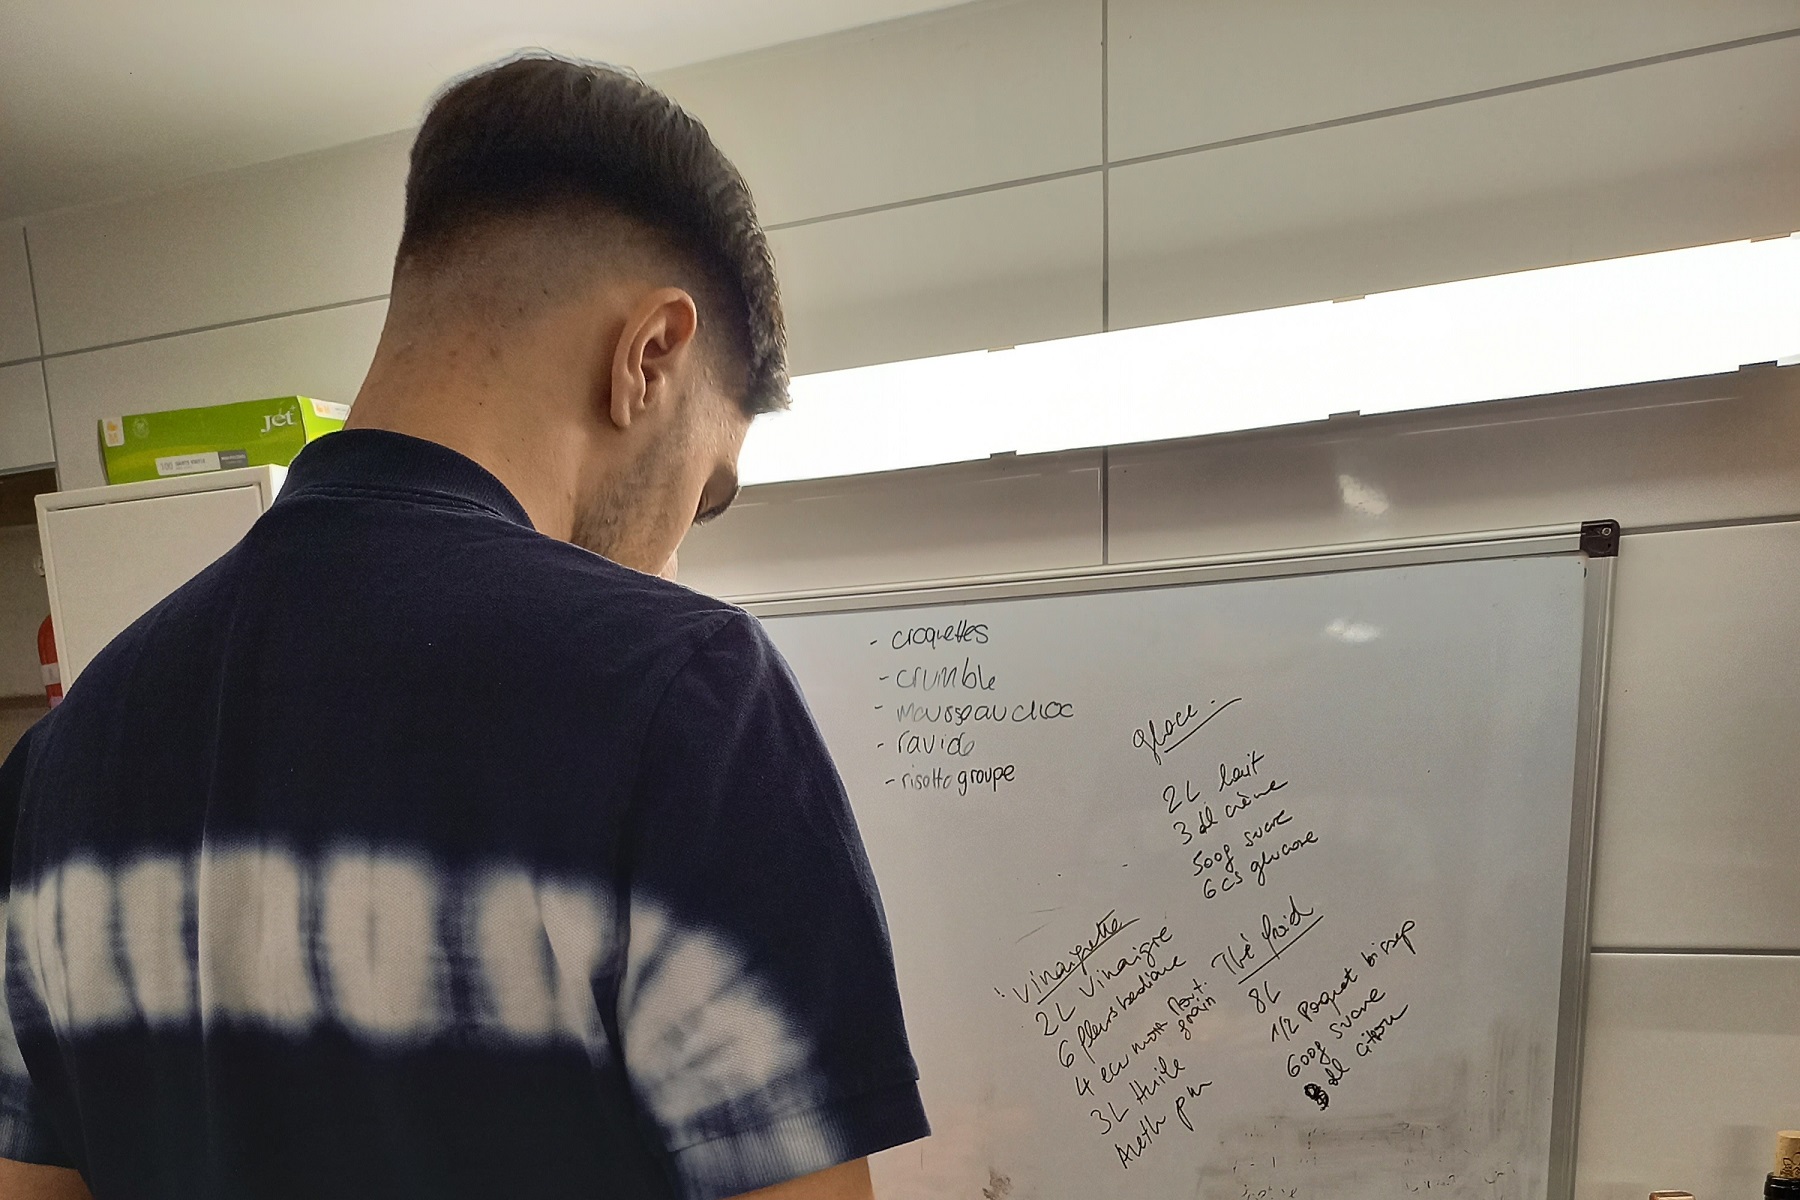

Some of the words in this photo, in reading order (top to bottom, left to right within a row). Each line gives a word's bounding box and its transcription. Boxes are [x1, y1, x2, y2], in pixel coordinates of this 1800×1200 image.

[891, 619, 989, 650] croquettes
[896, 657, 996, 691] crumble
[957, 764, 1016, 796] groupe
[1250, 830, 1319, 887] glucose
